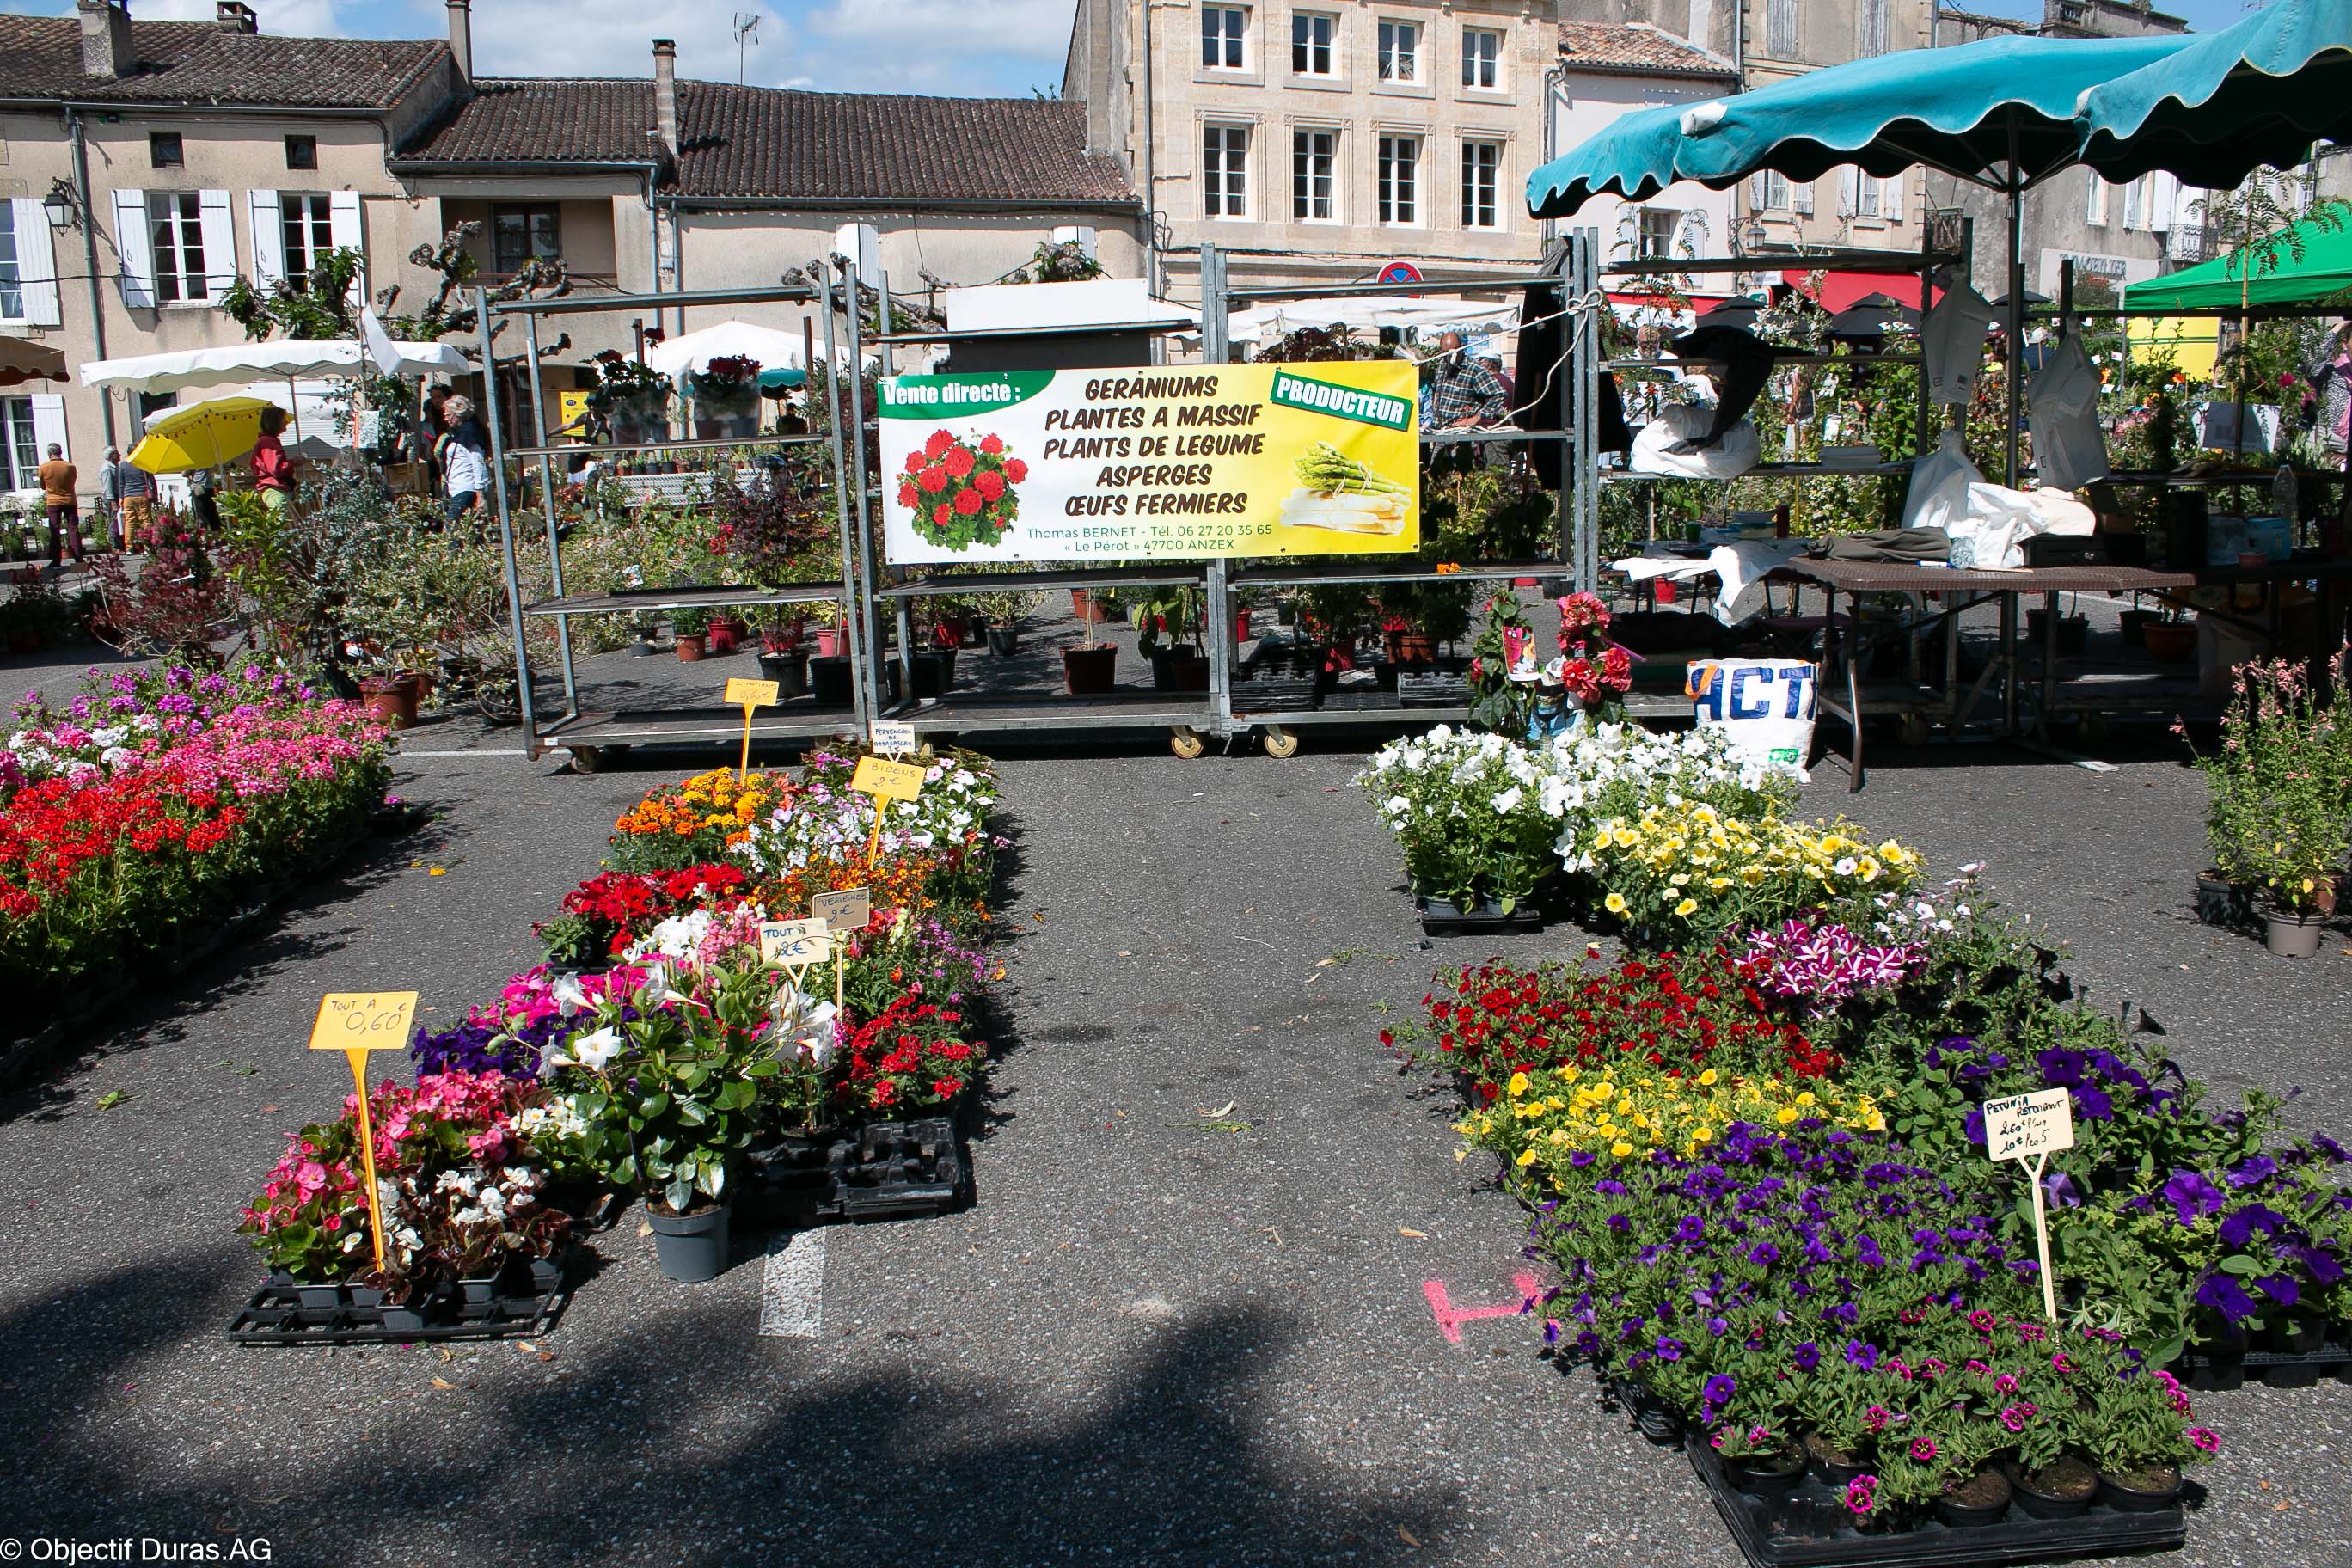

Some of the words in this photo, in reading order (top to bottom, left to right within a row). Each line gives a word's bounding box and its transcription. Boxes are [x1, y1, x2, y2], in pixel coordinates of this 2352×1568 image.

[884, 384, 938, 405] Vente
[942, 383, 1012, 403] directe
[1085, 376, 1218, 401] GERANIUMS
[1276, 377, 1405, 424] PRODUCTEUR
[1045, 407, 1145, 431] PLANTES
[1152, 407, 1168, 427] A
[1177, 404, 1263, 426] MASSIF
[1044, 437, 1130, 459] PLANTS
[1138, 436, 1168, 456] DE
[1175, 433, 1265, 456] LEGUME
[1096, 464, 1212, 487] ASPERGES
[1065, 494, 1128, 516] ŒUFS
[1135, 493, 1247, 515] FERMIERS
[1027, 528, 1078, 539] Thomas
[1083, 527, 1136, 537] BERNET
[1150, 526, 1173, 536] Tél.
[1177, 526, 1194, 536] 06
[1197, 526, 1213, 536] 27
[1216, 525, 1234, 536] 20
[1238, 525, 1253, 536] 35
[1257, 524, 1272, 535] 65
[1075, 542, 1090, 552] Le
[1094, 540, 1130, 552] Pérot
[1143, 540, 1184, 551] 47700
[1187, 539, 1234, 550] ANZEX
[871, 762, 915, 777] BIDENS
[822, 894, 867, 907] VERVEINES
[763, 928, 793, 938] TOUT
[331, 1000, 359, 1011] TOUT
[366, 999, 376, 1009] A
